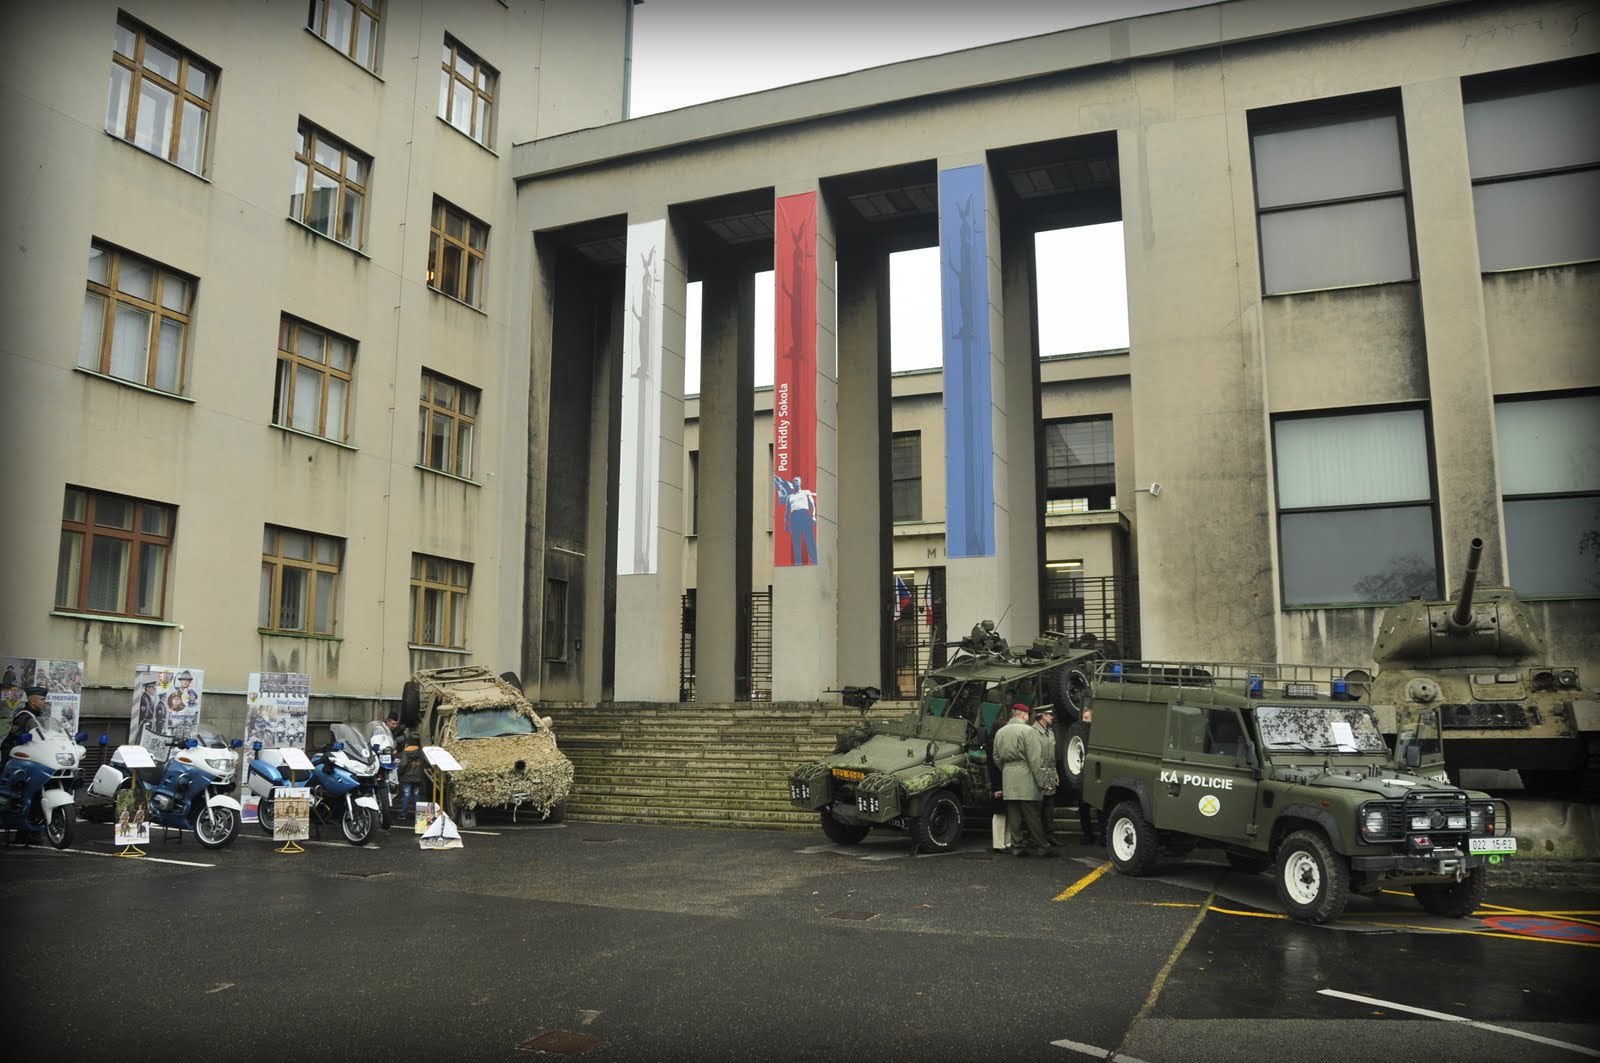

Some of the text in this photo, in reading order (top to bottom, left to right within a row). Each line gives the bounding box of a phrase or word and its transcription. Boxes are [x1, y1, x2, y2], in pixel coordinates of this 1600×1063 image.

[778, 383, 790, 472] Pod křídly Sokola
[1160, 770, 1233, 790] KÁ POLICIE
[1472, 839, 1486, 850] 022
